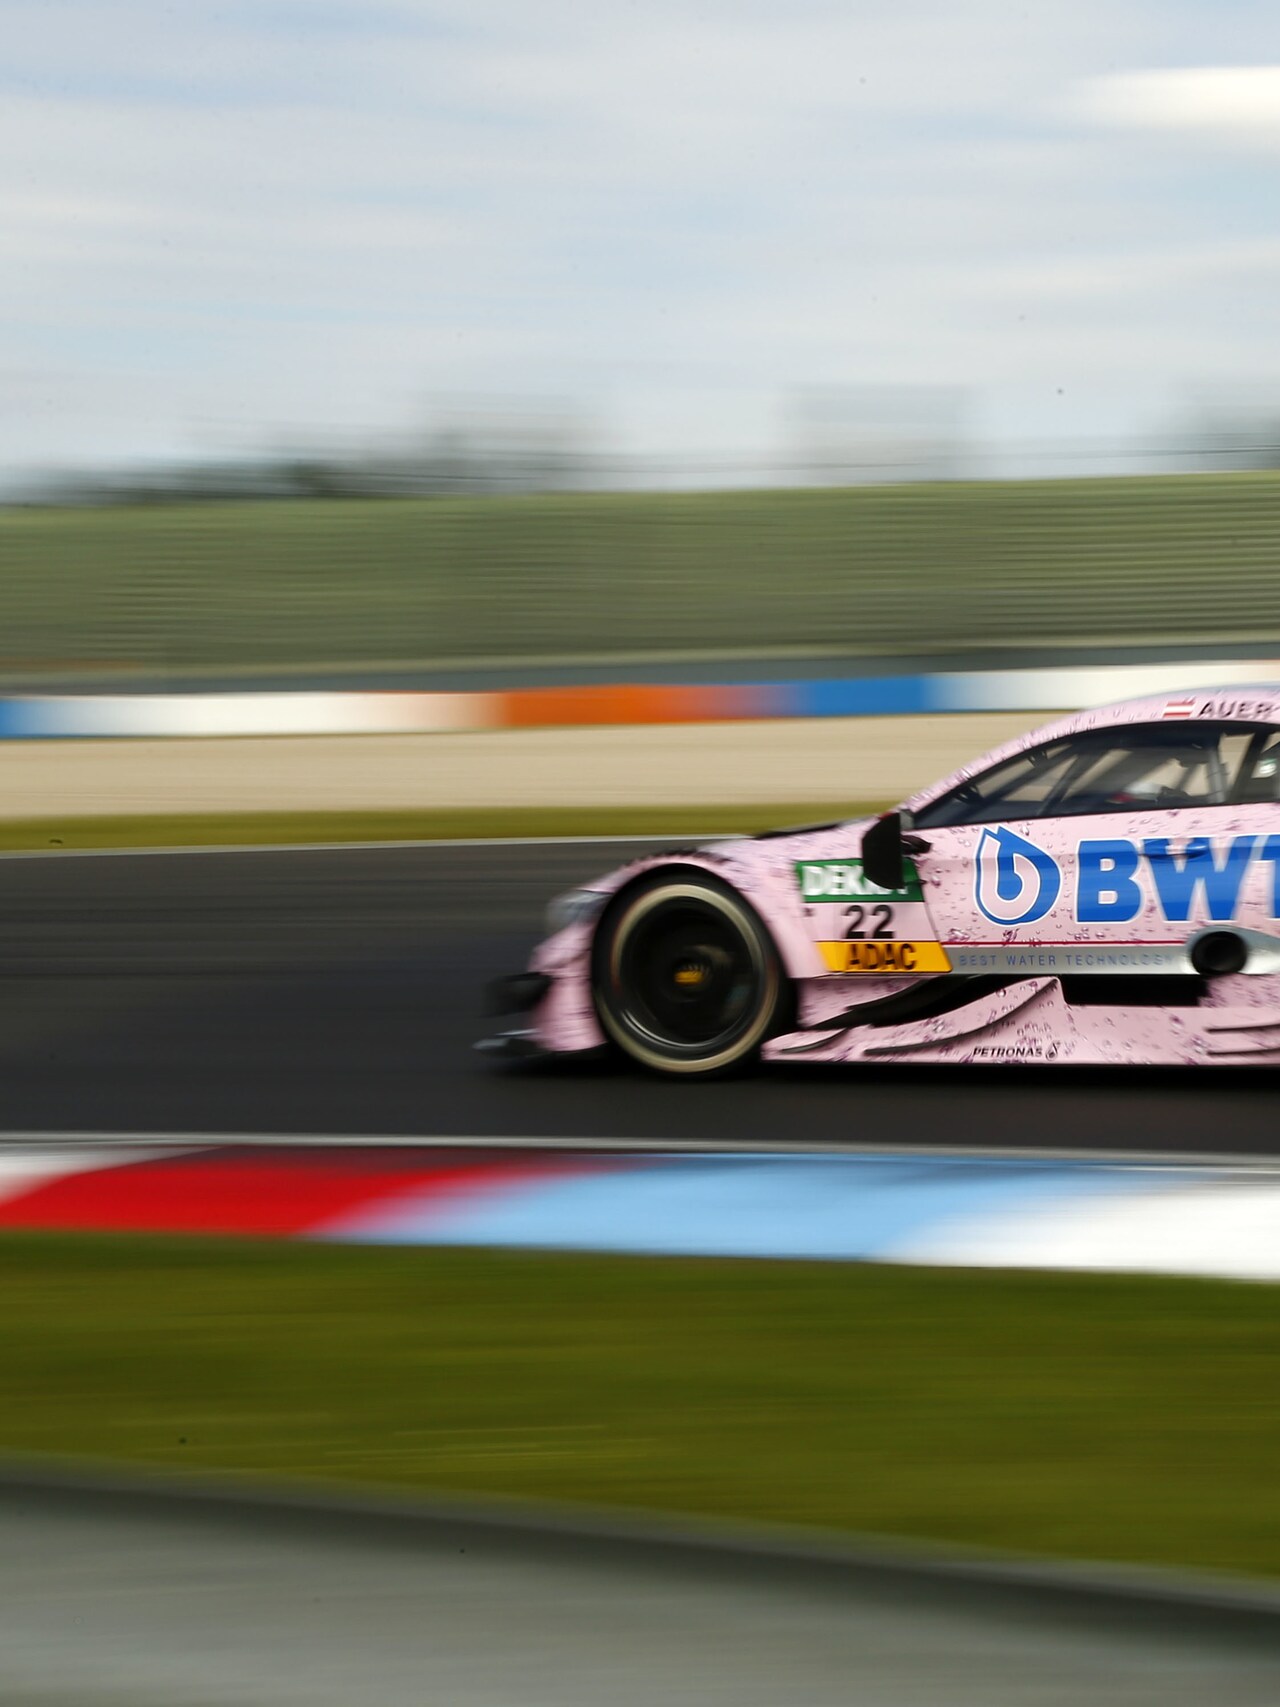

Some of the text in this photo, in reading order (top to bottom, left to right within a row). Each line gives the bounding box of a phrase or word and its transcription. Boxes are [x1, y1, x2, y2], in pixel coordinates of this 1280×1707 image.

[1198, 700, 1276, 719] AUER
[802, 865, 909, 895] DEK
[843, 905, 895, 939] 22
[846, 944, 917, 970] ADAC
[959, 954, 1174, 966] BEST WATER TECHNOLOGY
[973, 1047, 1043, 1058] PETRONAS
